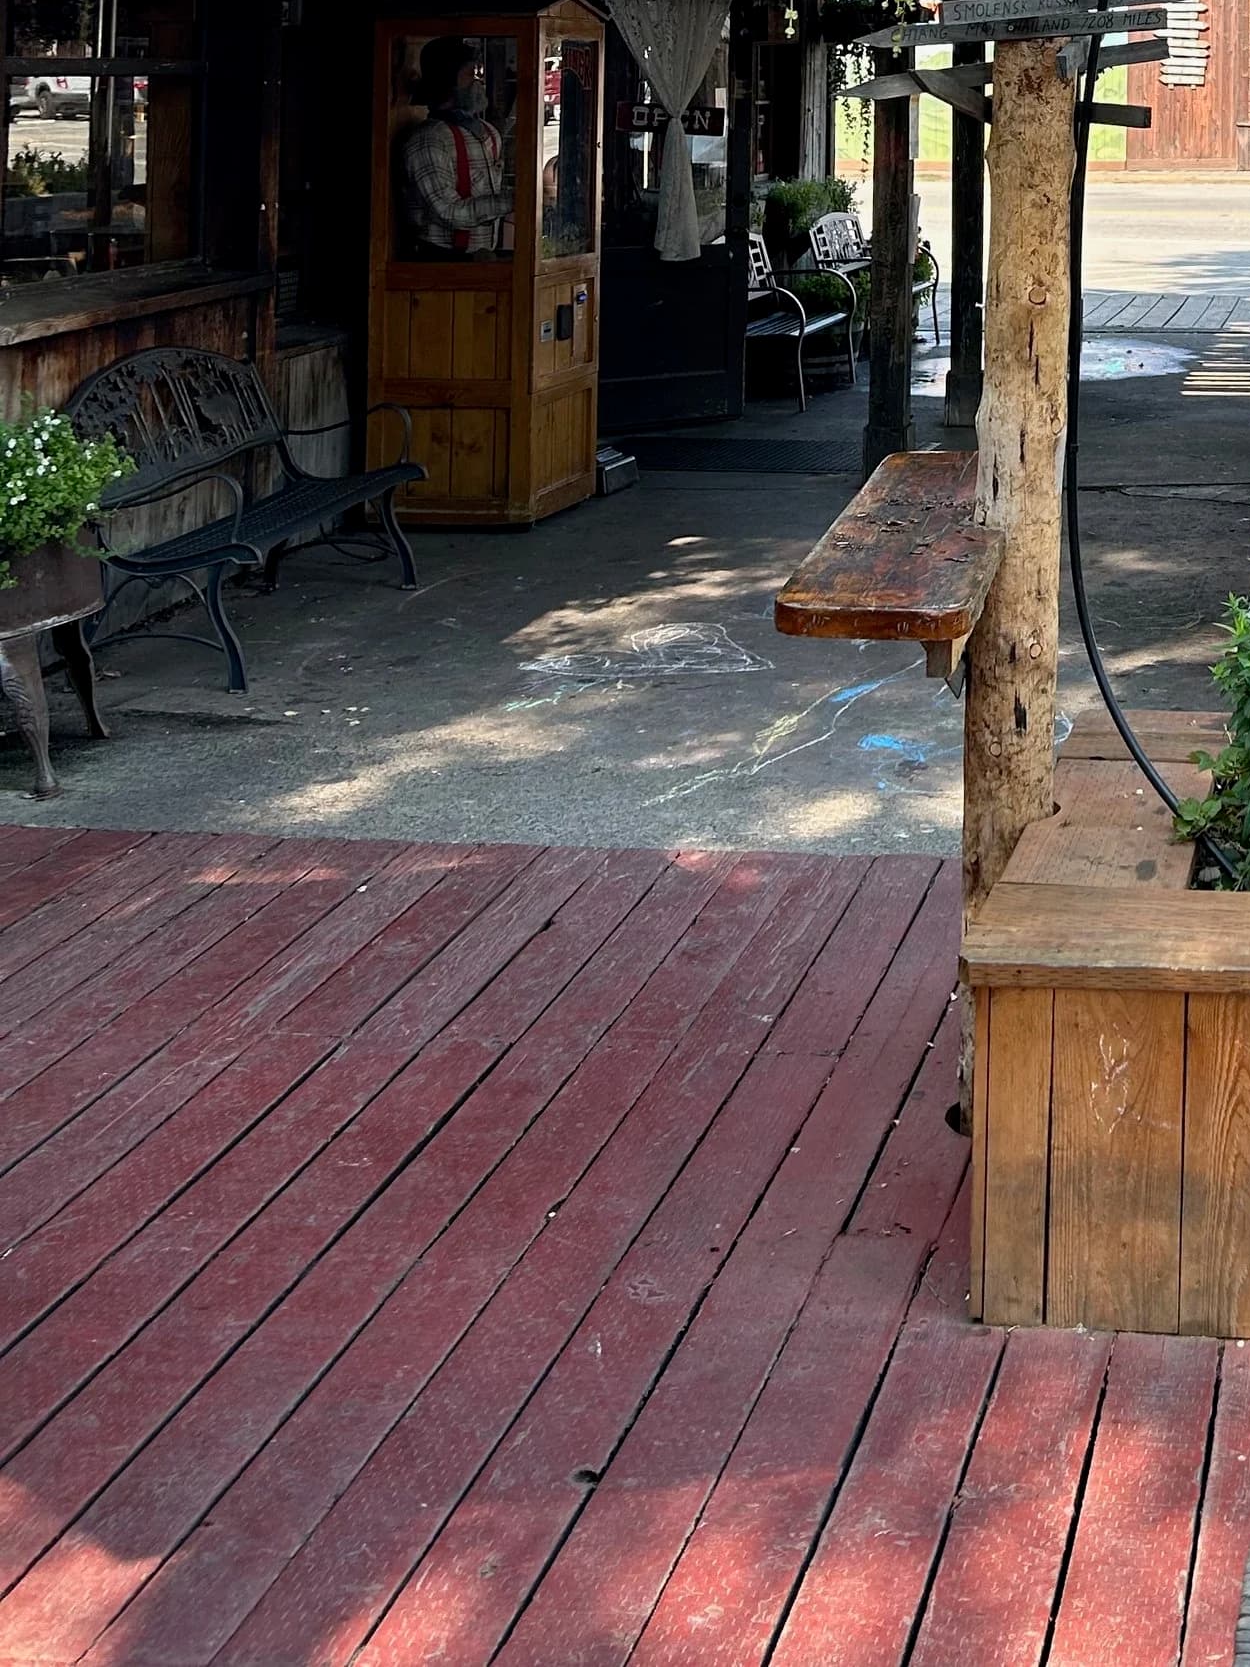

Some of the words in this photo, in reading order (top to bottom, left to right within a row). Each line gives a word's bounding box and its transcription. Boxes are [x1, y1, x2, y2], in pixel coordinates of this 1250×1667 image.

[952, 0, 1028, 22] SMOLENSK
[1080, 14, 1114, 30] 7208
[1123, 11, 1162, 26] MILES
[632, 106, 711, 130] OPN
